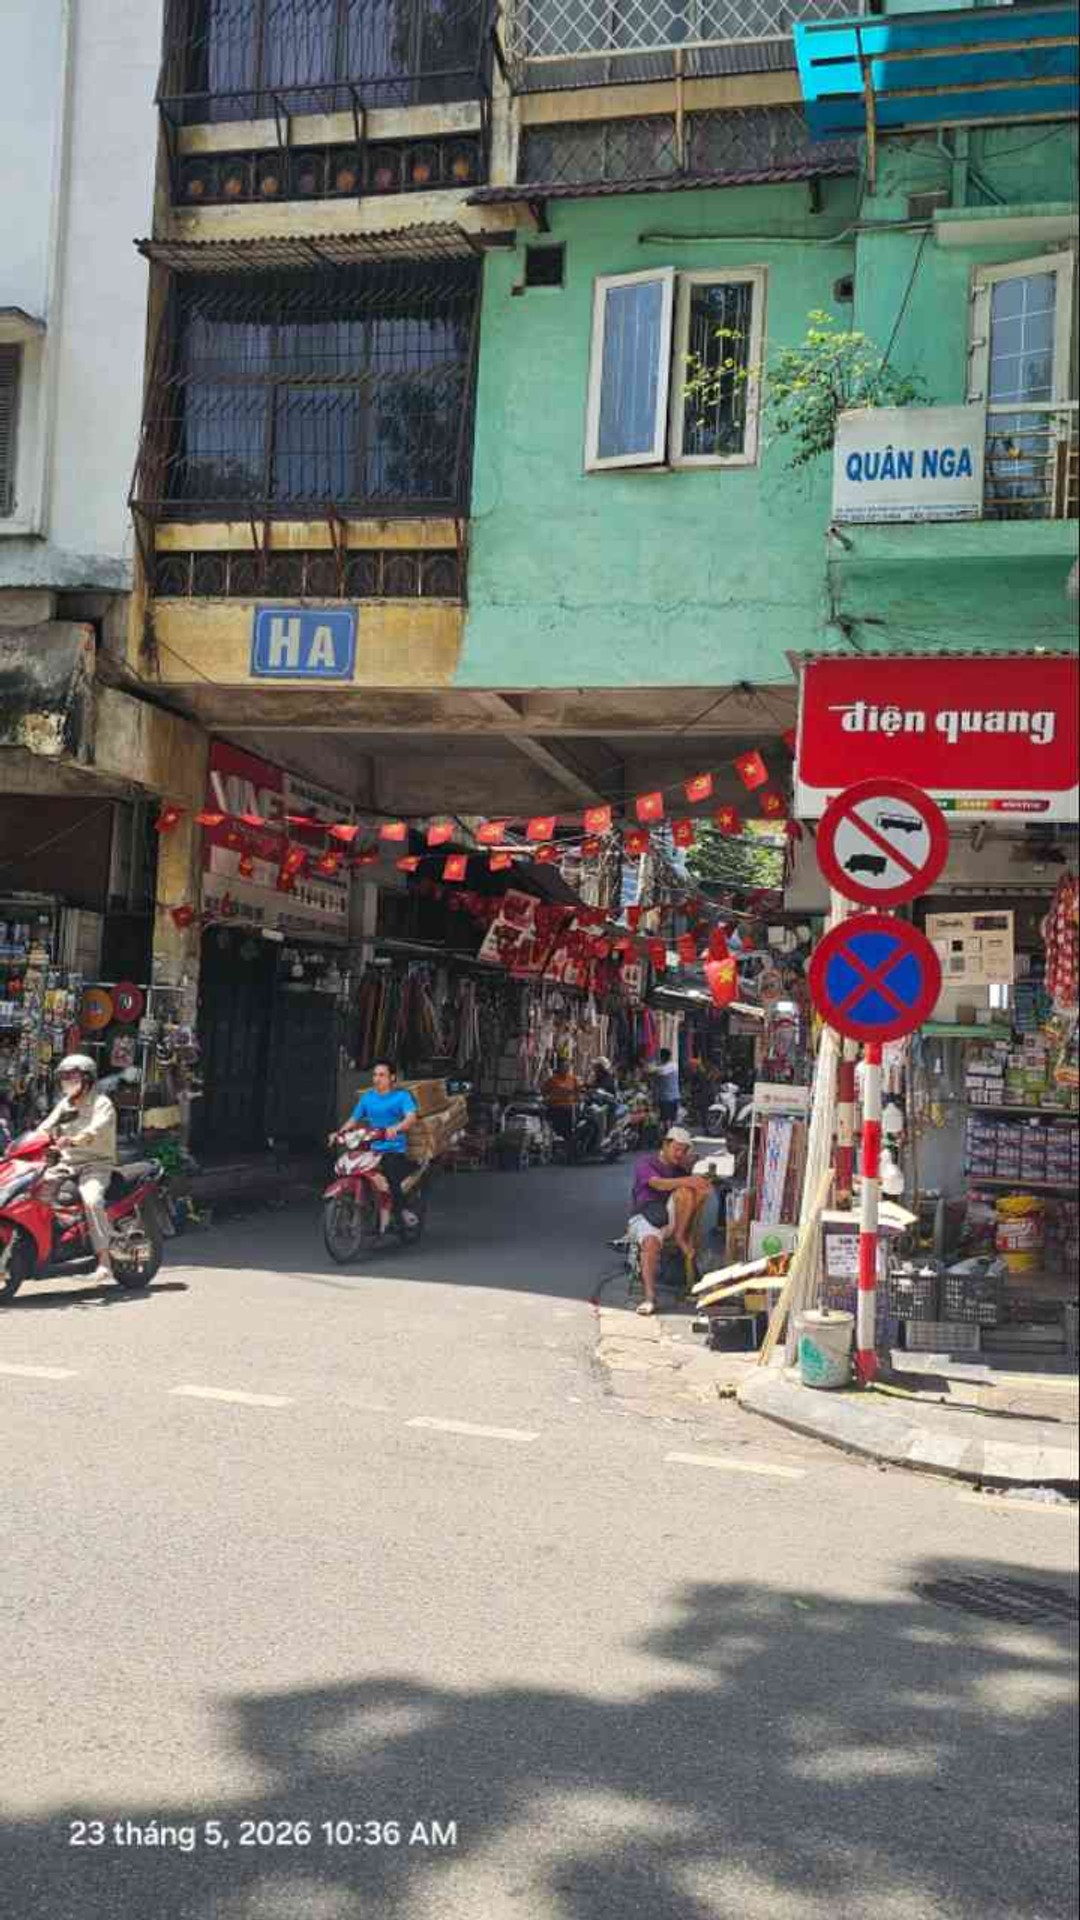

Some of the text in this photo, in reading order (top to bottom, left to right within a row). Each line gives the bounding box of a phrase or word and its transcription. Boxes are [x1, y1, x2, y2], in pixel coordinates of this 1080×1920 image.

[846, 444, 972, 482] QUÂN NGA
[828, 700, 1055, 744] điện quang
